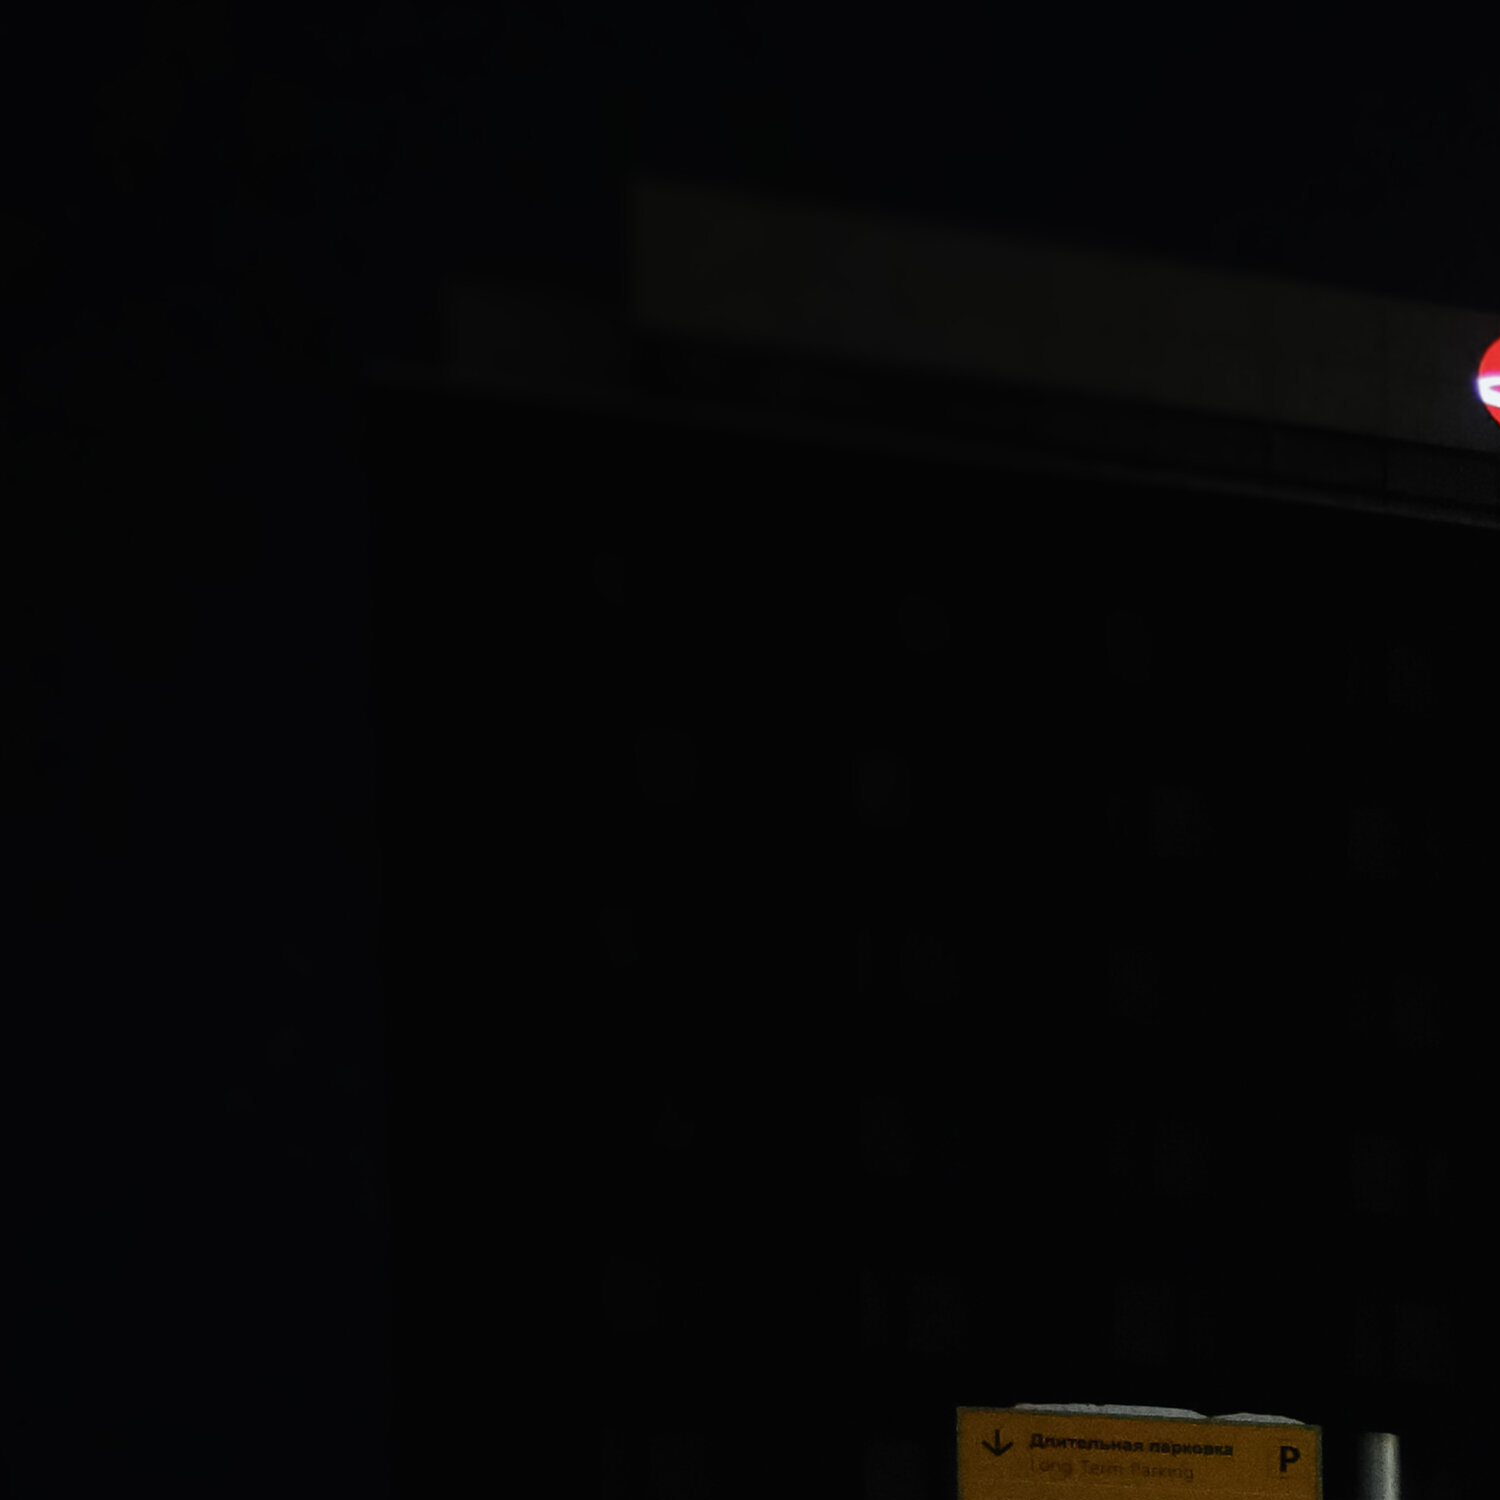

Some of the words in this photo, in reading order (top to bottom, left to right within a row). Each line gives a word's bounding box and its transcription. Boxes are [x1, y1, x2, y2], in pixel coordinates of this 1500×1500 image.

[1029, 1433, 1144, 1452] Длительная
[1149, 1440, 1234, 1457] парковка
[1278, 1445, 1301, 1472] P
